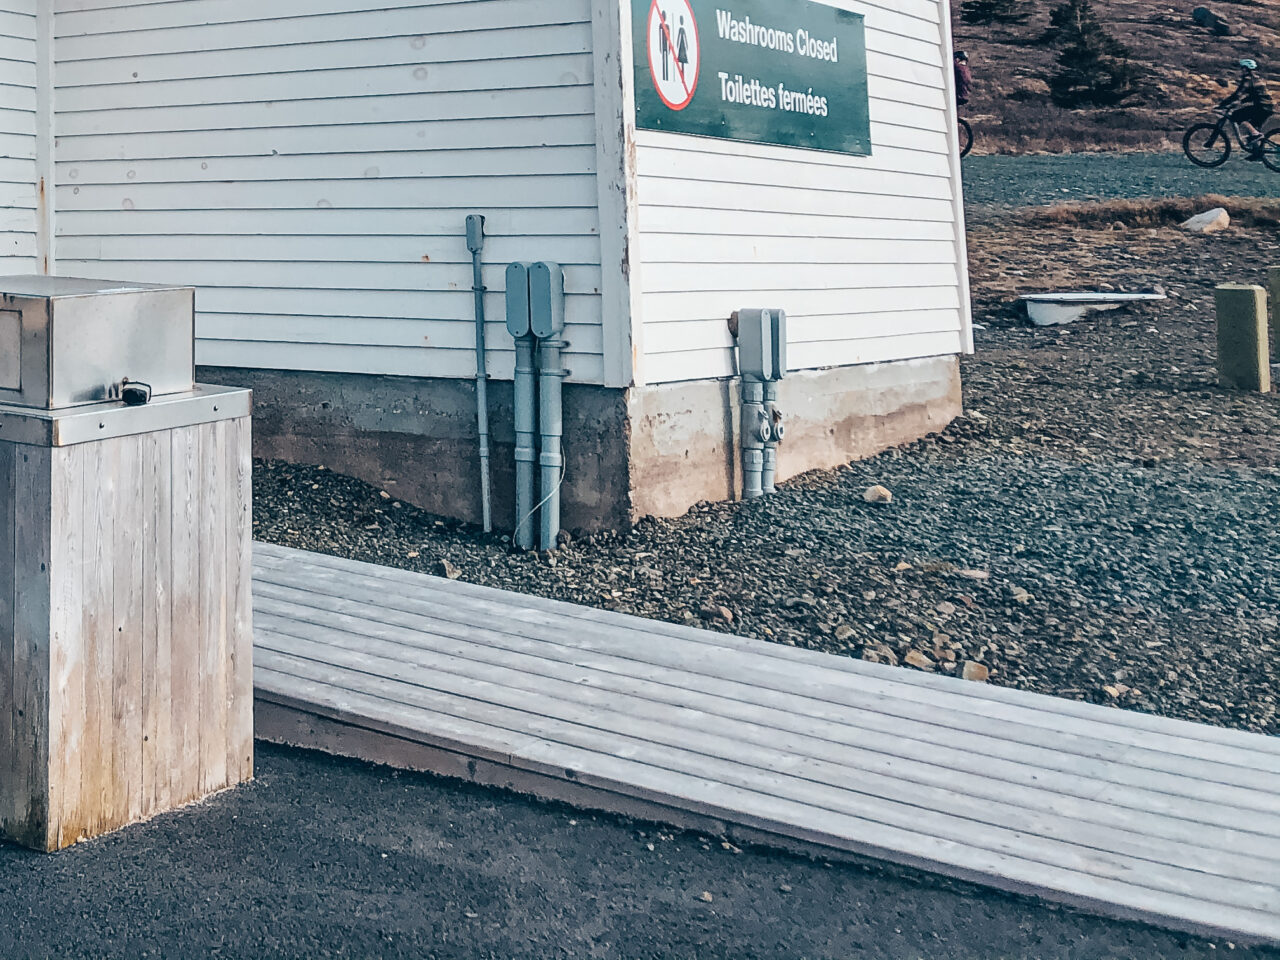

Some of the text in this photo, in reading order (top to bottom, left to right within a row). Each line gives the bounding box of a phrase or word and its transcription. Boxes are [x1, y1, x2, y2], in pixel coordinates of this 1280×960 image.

[716, 9, 838, 63] Washrooms Closed
[718, 72, 828, 117] Toilettes fermées
